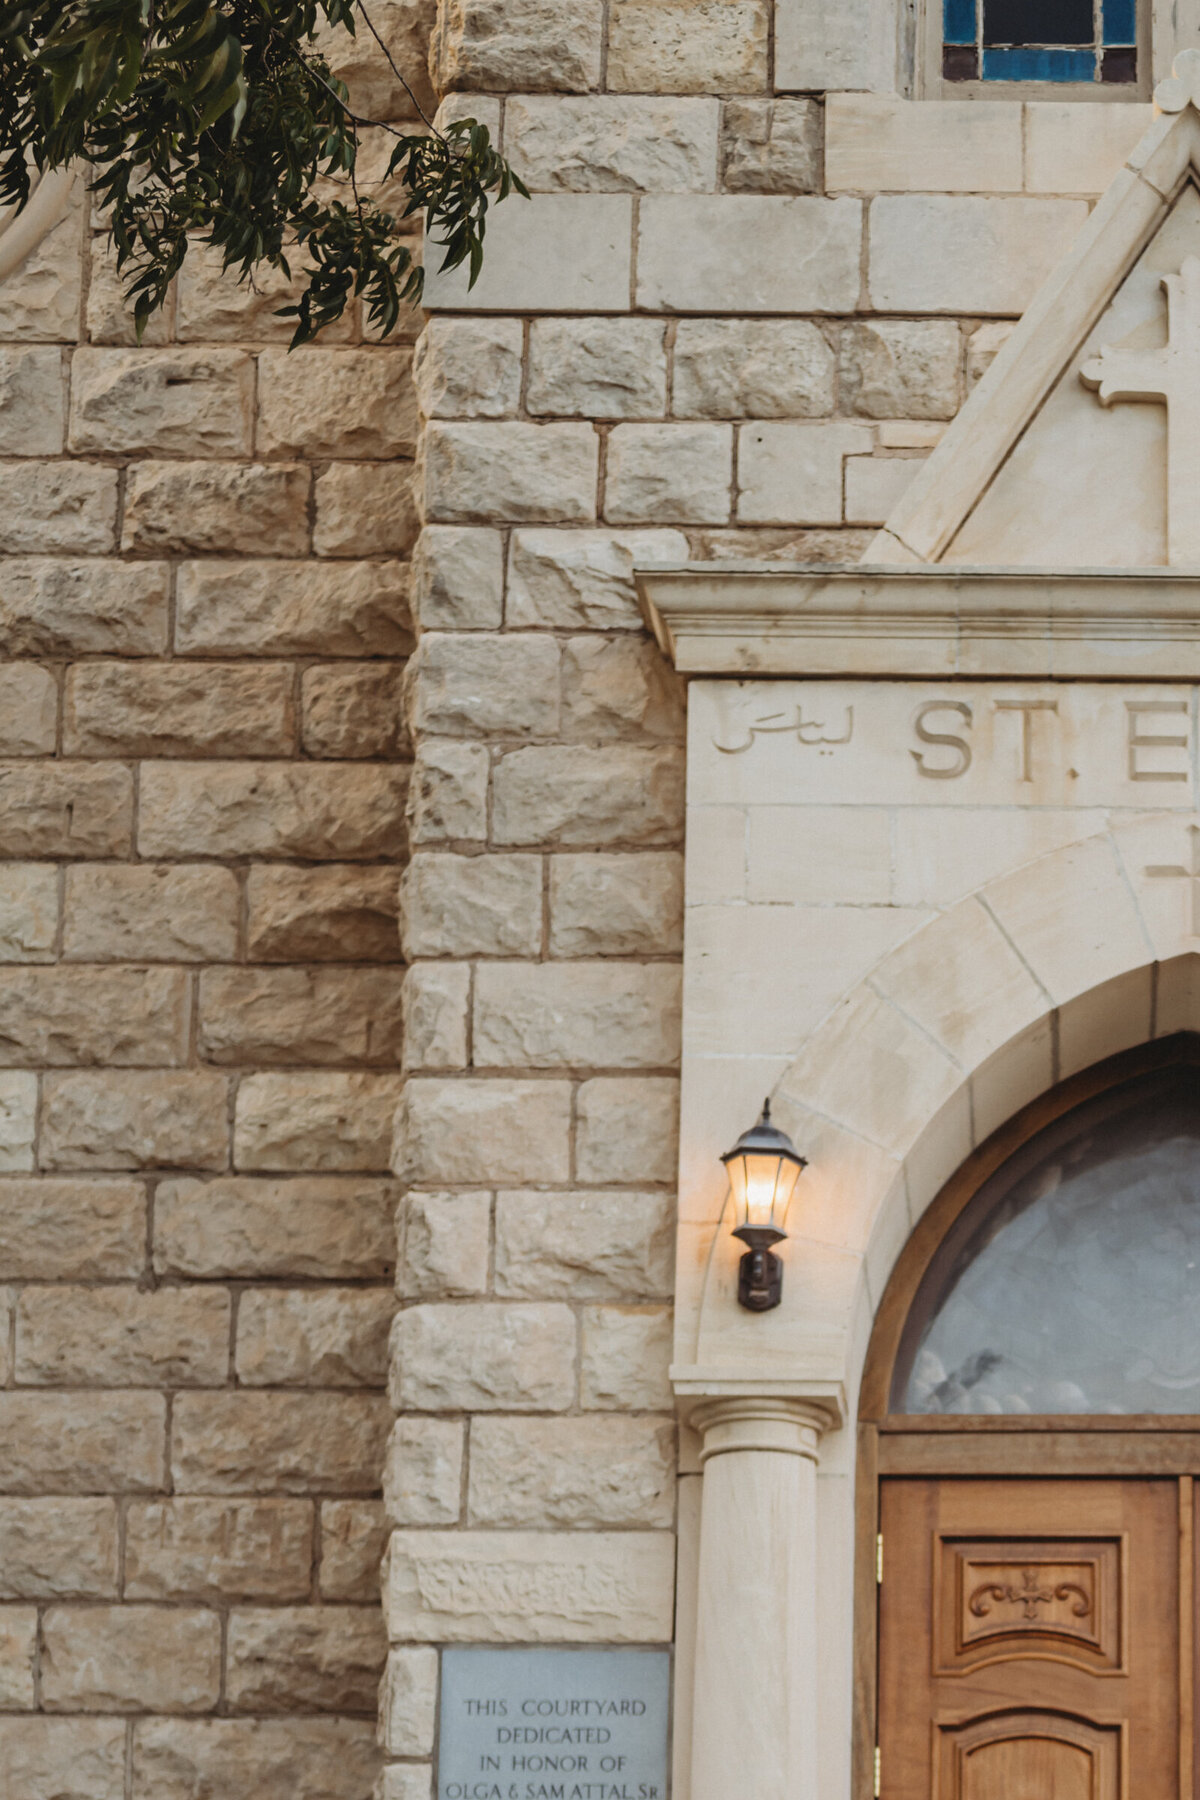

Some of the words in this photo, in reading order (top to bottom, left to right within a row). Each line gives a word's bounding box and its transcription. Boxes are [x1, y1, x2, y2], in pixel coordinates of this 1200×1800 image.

[908, 699, 1080, 783] ST.
[464, 1699, 508, 1717] THIS
[521, 1699, 647, 1717] COURTYARD
[497, 1727, 611, 1744] DEDICATED
[480, 1755, 500, 1771] IN
[512, 1755, 588, 1772] HONOR
[600, 1755, 627, 1772] OF
[446, 1782, 502, 1800] OLGA
[508, 1783, 519, 1799] &
[525, 1783, 565, 1800] SAM
